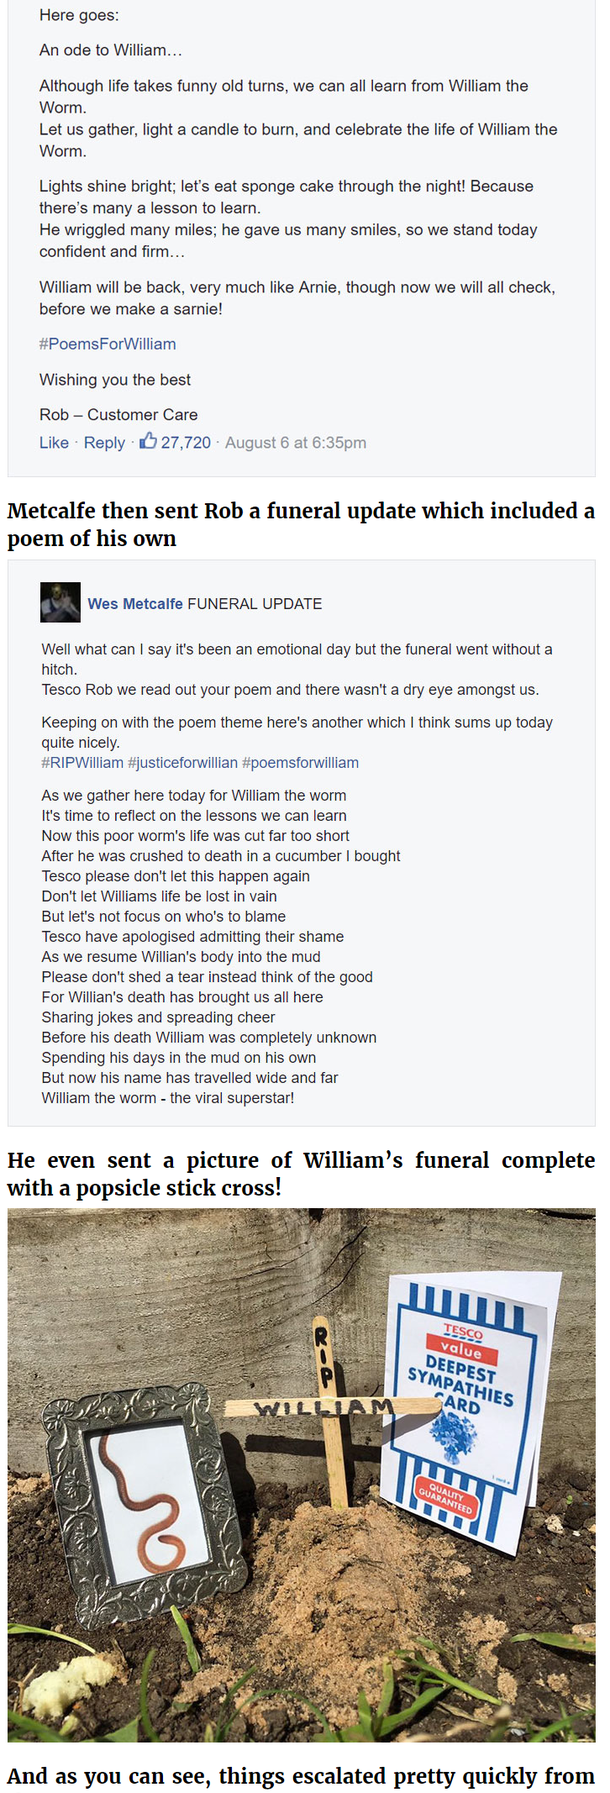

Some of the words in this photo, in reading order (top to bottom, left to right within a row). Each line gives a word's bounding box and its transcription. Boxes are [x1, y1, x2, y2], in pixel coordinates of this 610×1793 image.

[40, 338, 176, 350] #PoemsForWilliam
[88, 598, 118, 609] Wes
[123, 598, 183, 609] Metcalfe
[188, 598, 258, 609] FUNERAL
[263, 598, 322, 609] UPDATE
[42, 757, 123, 768] #RIPWilliam
[128, 757, 237, 771] #justiceforwillian
[242, 757, 358, 771] #poemsforwilliam
[444, 1323, 483, 1340] TESCO
[315, 1327, 333, 1389] RIP
[440, 1341, 483, 1360] value
[426, 1355, 497, 1384] DEEPEST
[408, 1367, 515, 1408] SYMPATHIES
[253, 1399, 395, 1416] WILLIAM
[419, 1488, 473, 1515] GUARANTEED
[429, 1482, 465, 1502] QUALITY
